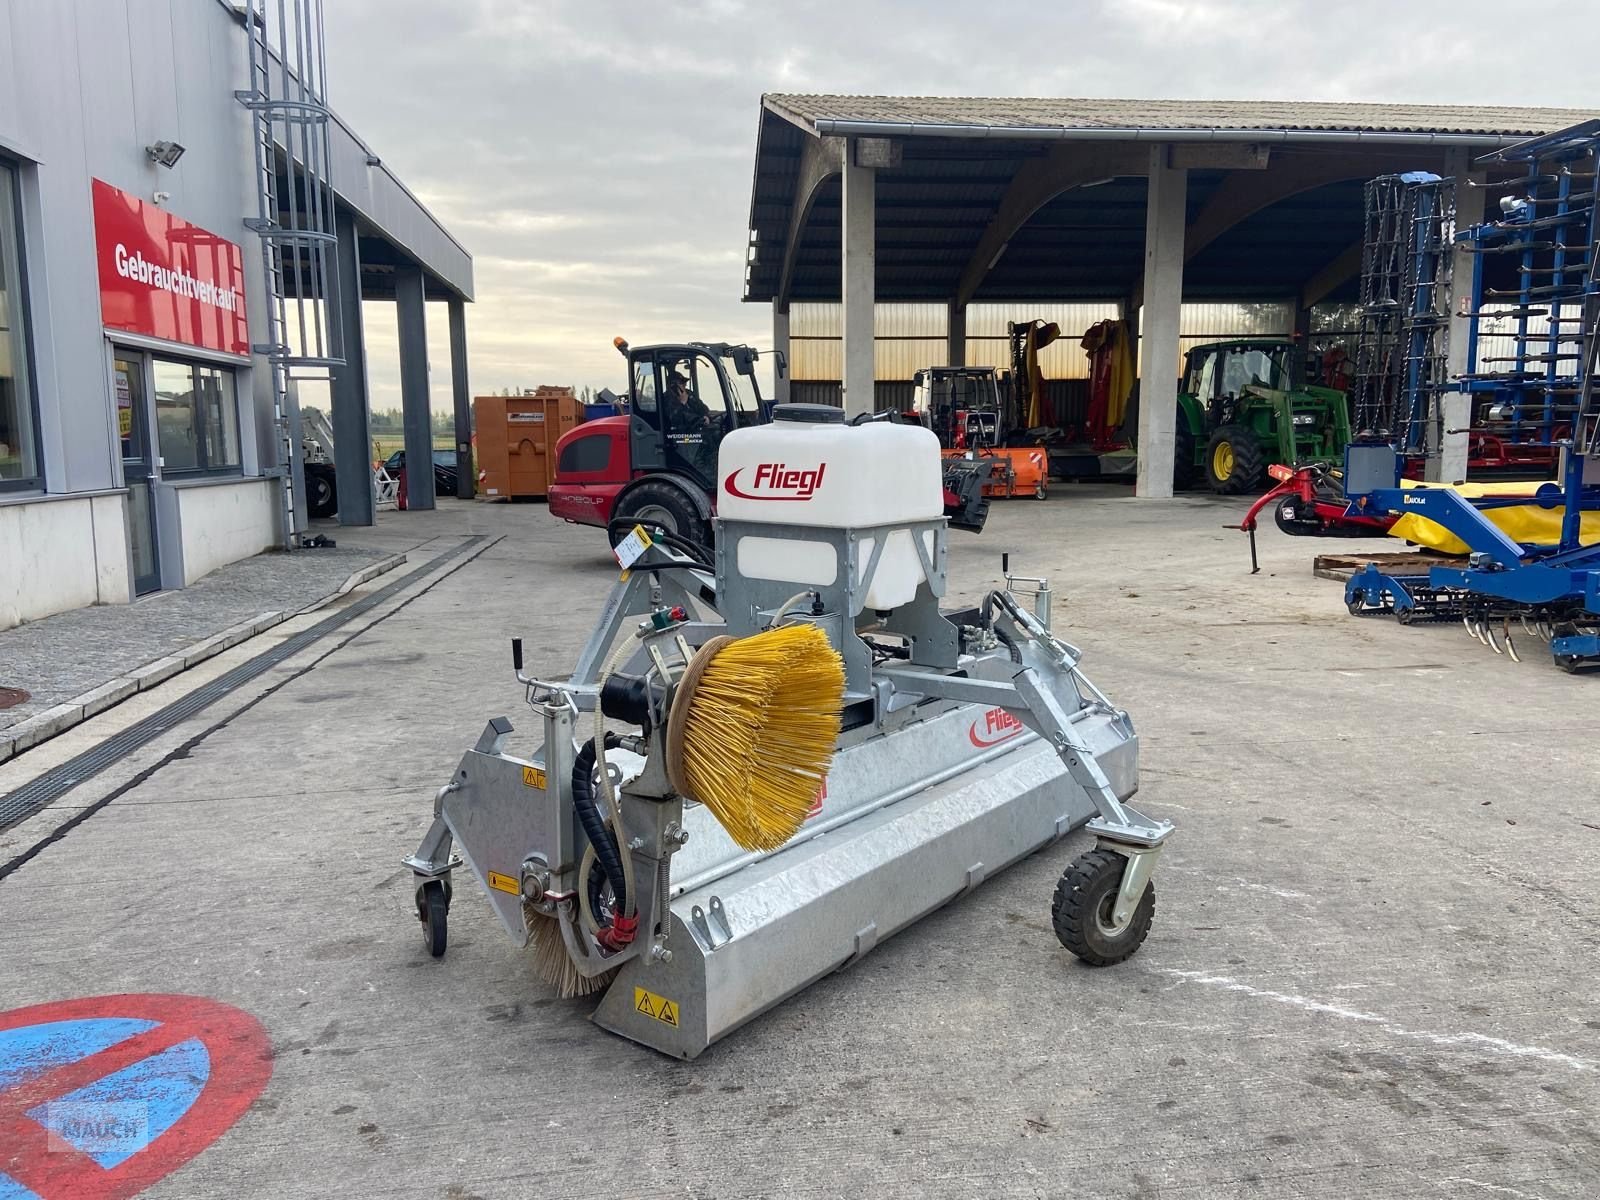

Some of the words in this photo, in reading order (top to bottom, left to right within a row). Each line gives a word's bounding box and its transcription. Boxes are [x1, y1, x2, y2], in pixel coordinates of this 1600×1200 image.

[115, 243, 237, 313] Gebrauchtverkauf
[753, 462, 826, 496] Fliegl
[985, 707, 1023, 735] Flieg
